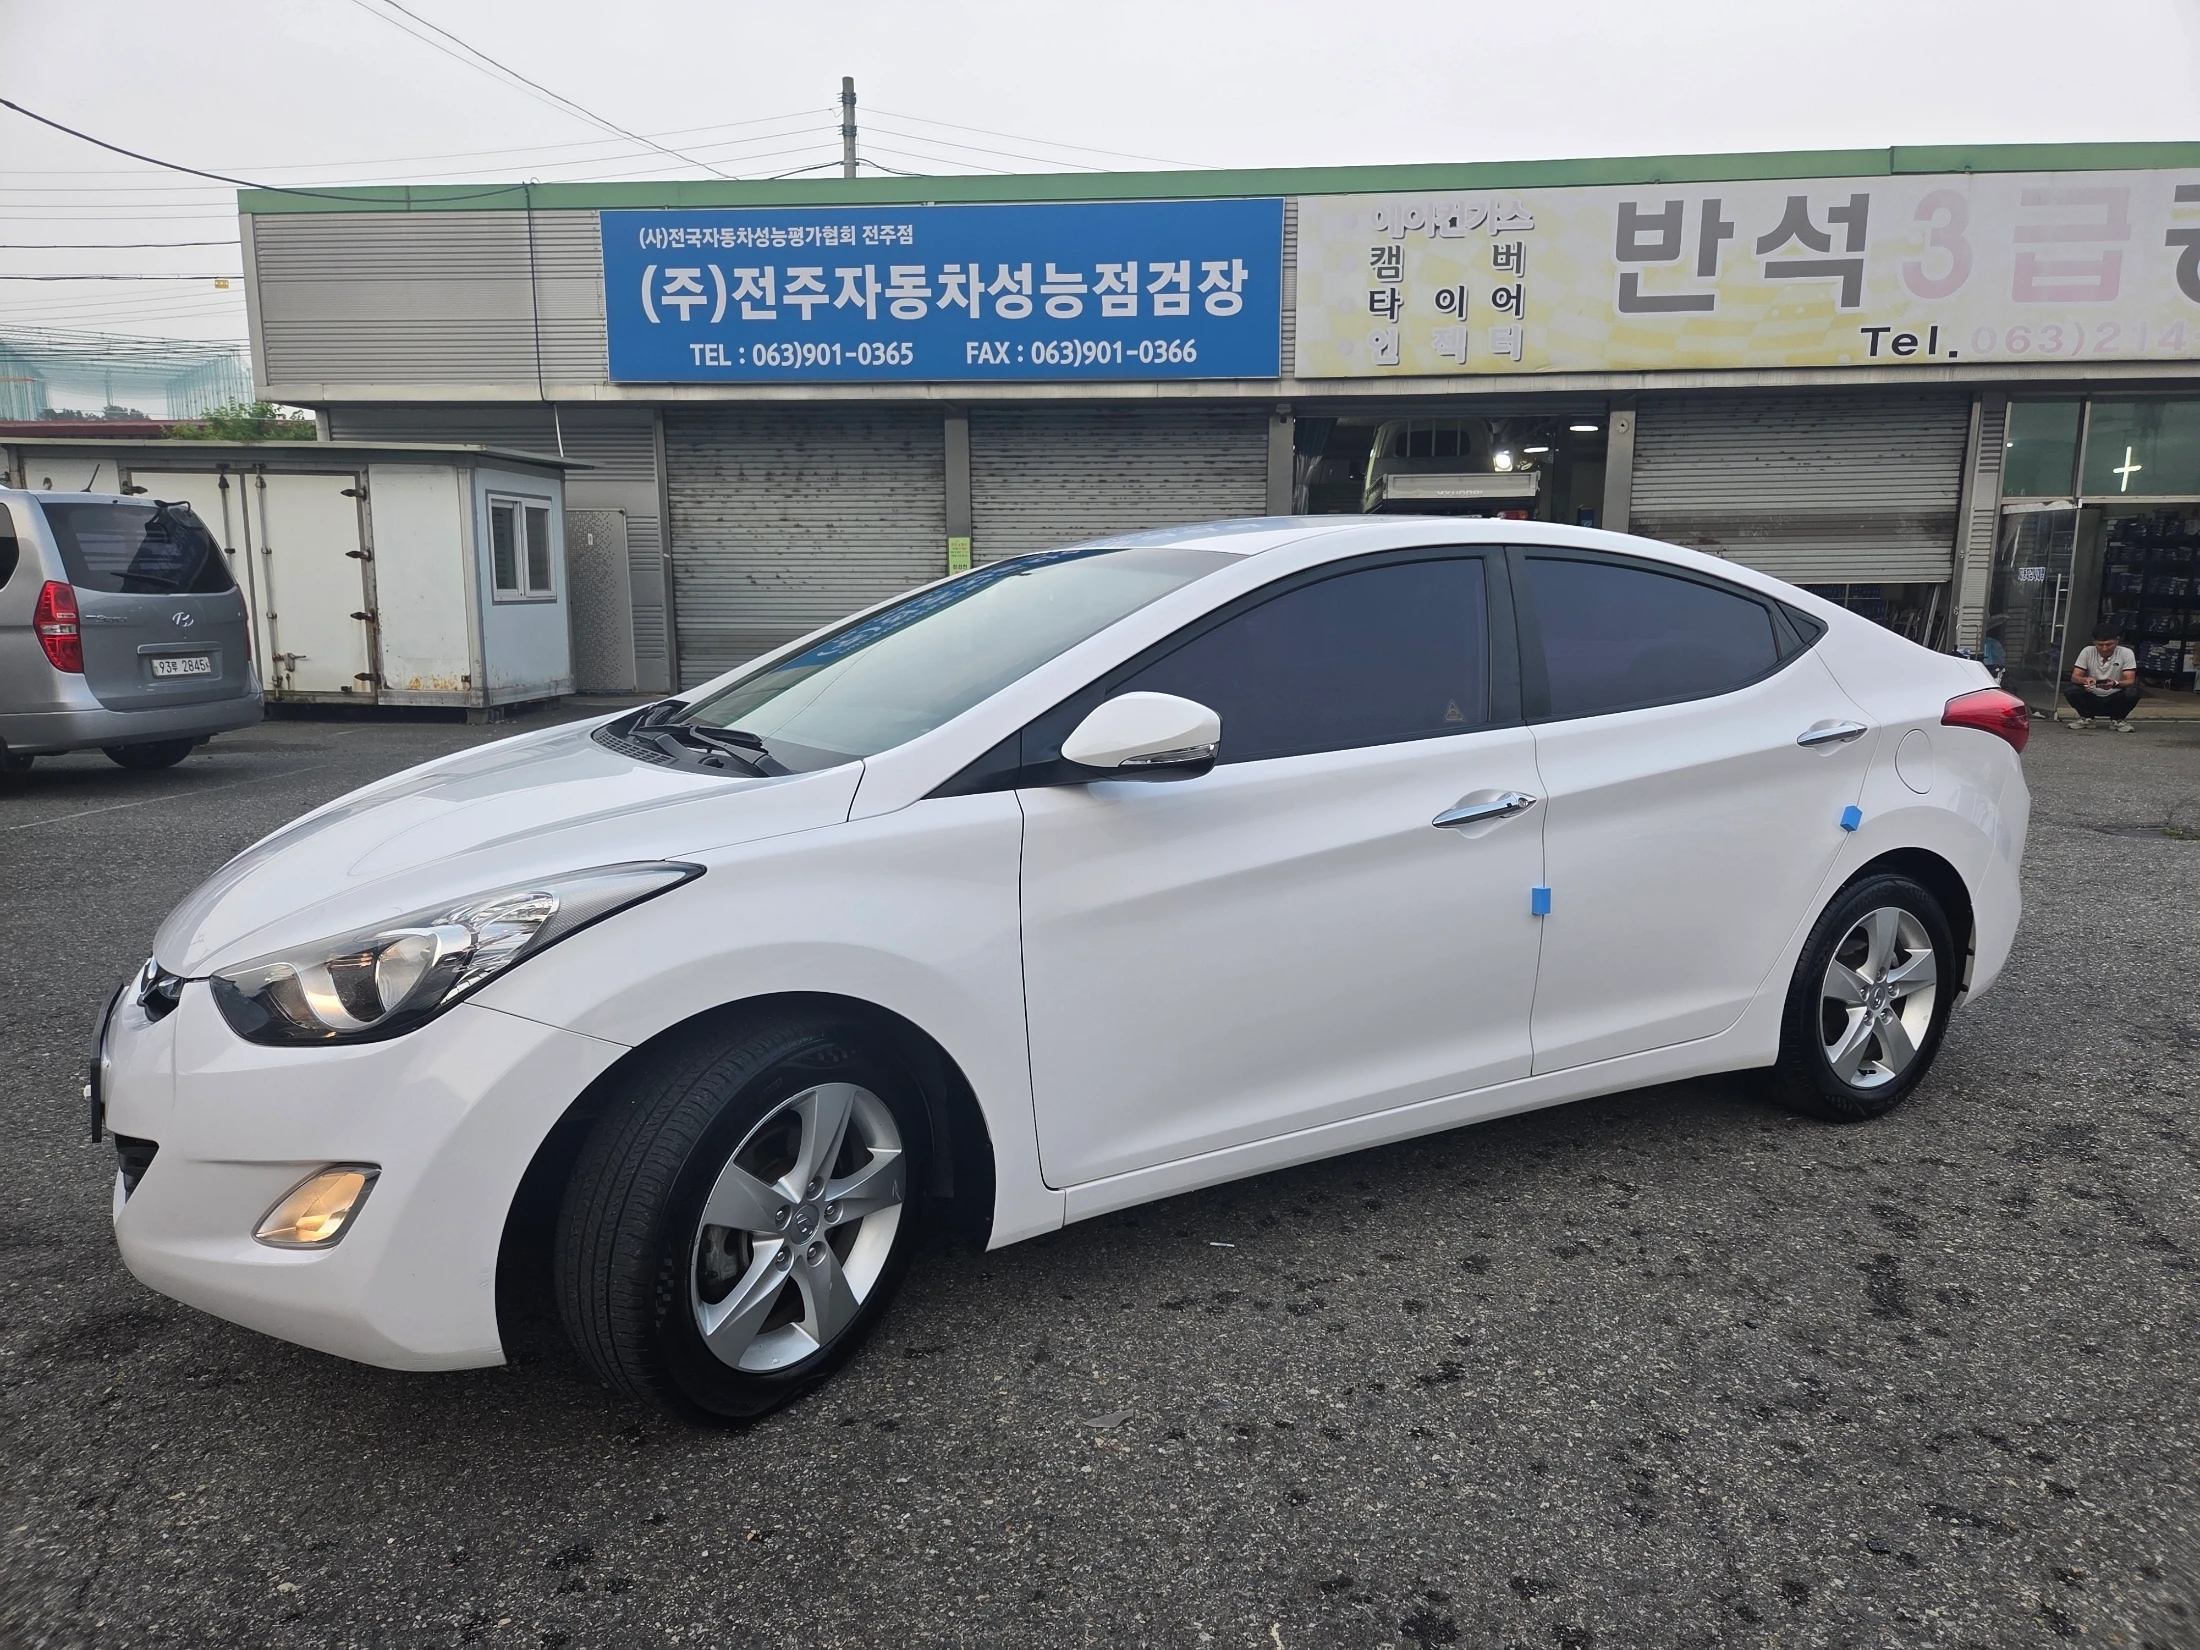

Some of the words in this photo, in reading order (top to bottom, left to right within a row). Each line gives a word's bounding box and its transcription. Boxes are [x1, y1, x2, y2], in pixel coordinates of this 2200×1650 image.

[639, 225, 856, 250] (사)전국자동차성능평가협회
[862, 224, 913, 246] 전주점
[641, 258, 1248, 324] (주)전주자동차성능점검장
[690, 343, 732, 366] TEL
[752, 341, 913, 369] 063)901-0365
[966, 341, 1010, 364] FAX
[1031, 339, 1197, 367] 063)901-0366
[1860, 325, 1958, 359] Tel.
[181, 659, 206, 673] 2845
